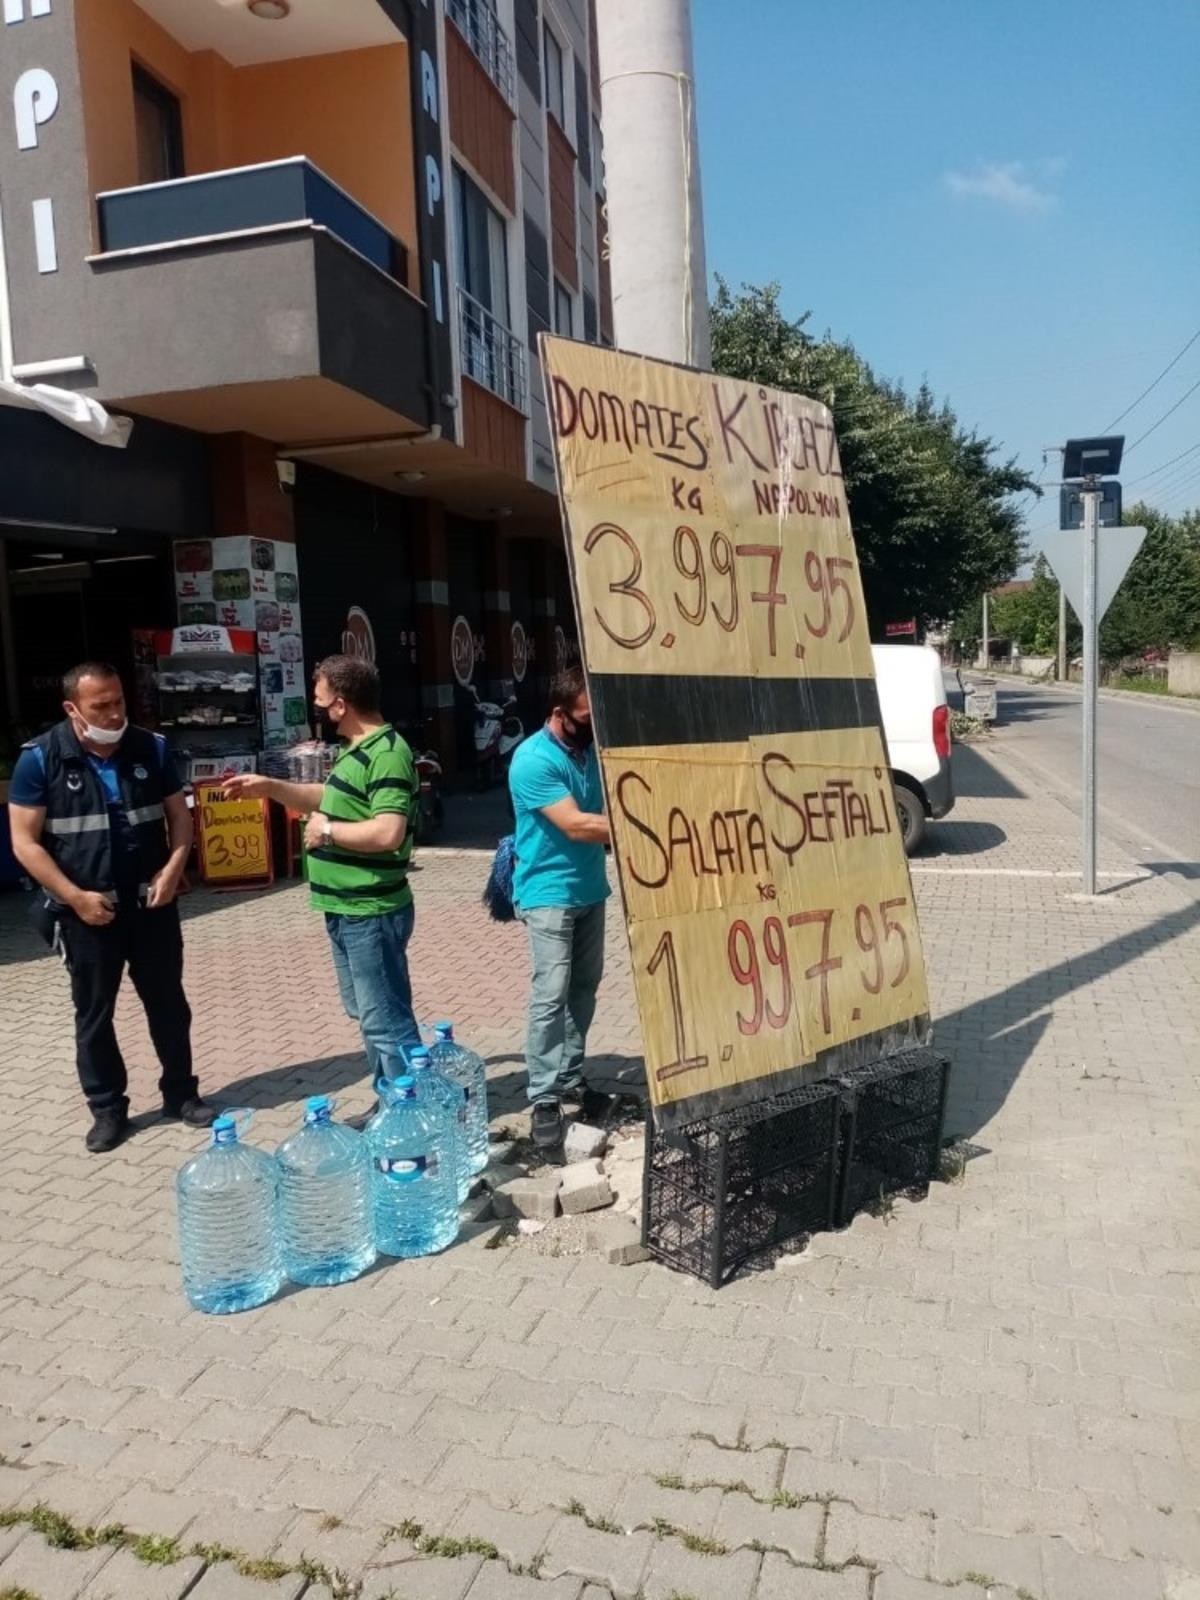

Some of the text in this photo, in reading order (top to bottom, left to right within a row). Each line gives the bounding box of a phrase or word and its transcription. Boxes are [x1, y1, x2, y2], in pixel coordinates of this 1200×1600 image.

[552, 375, 710, 470] DOMATES
[672, 477, 704, 515] KG
[584, 522, 739, 650] 3.99
[735, 544, 855, 659] 7.95
[207, 833, 261, 866] 3.99
[616, 770, 769, 889] SALATA
[761, 751, 892, 867] ŞEFTALİ
[646, 915, 792, 1082] 1.99
[787, 897, 910, 1034] 7.95
